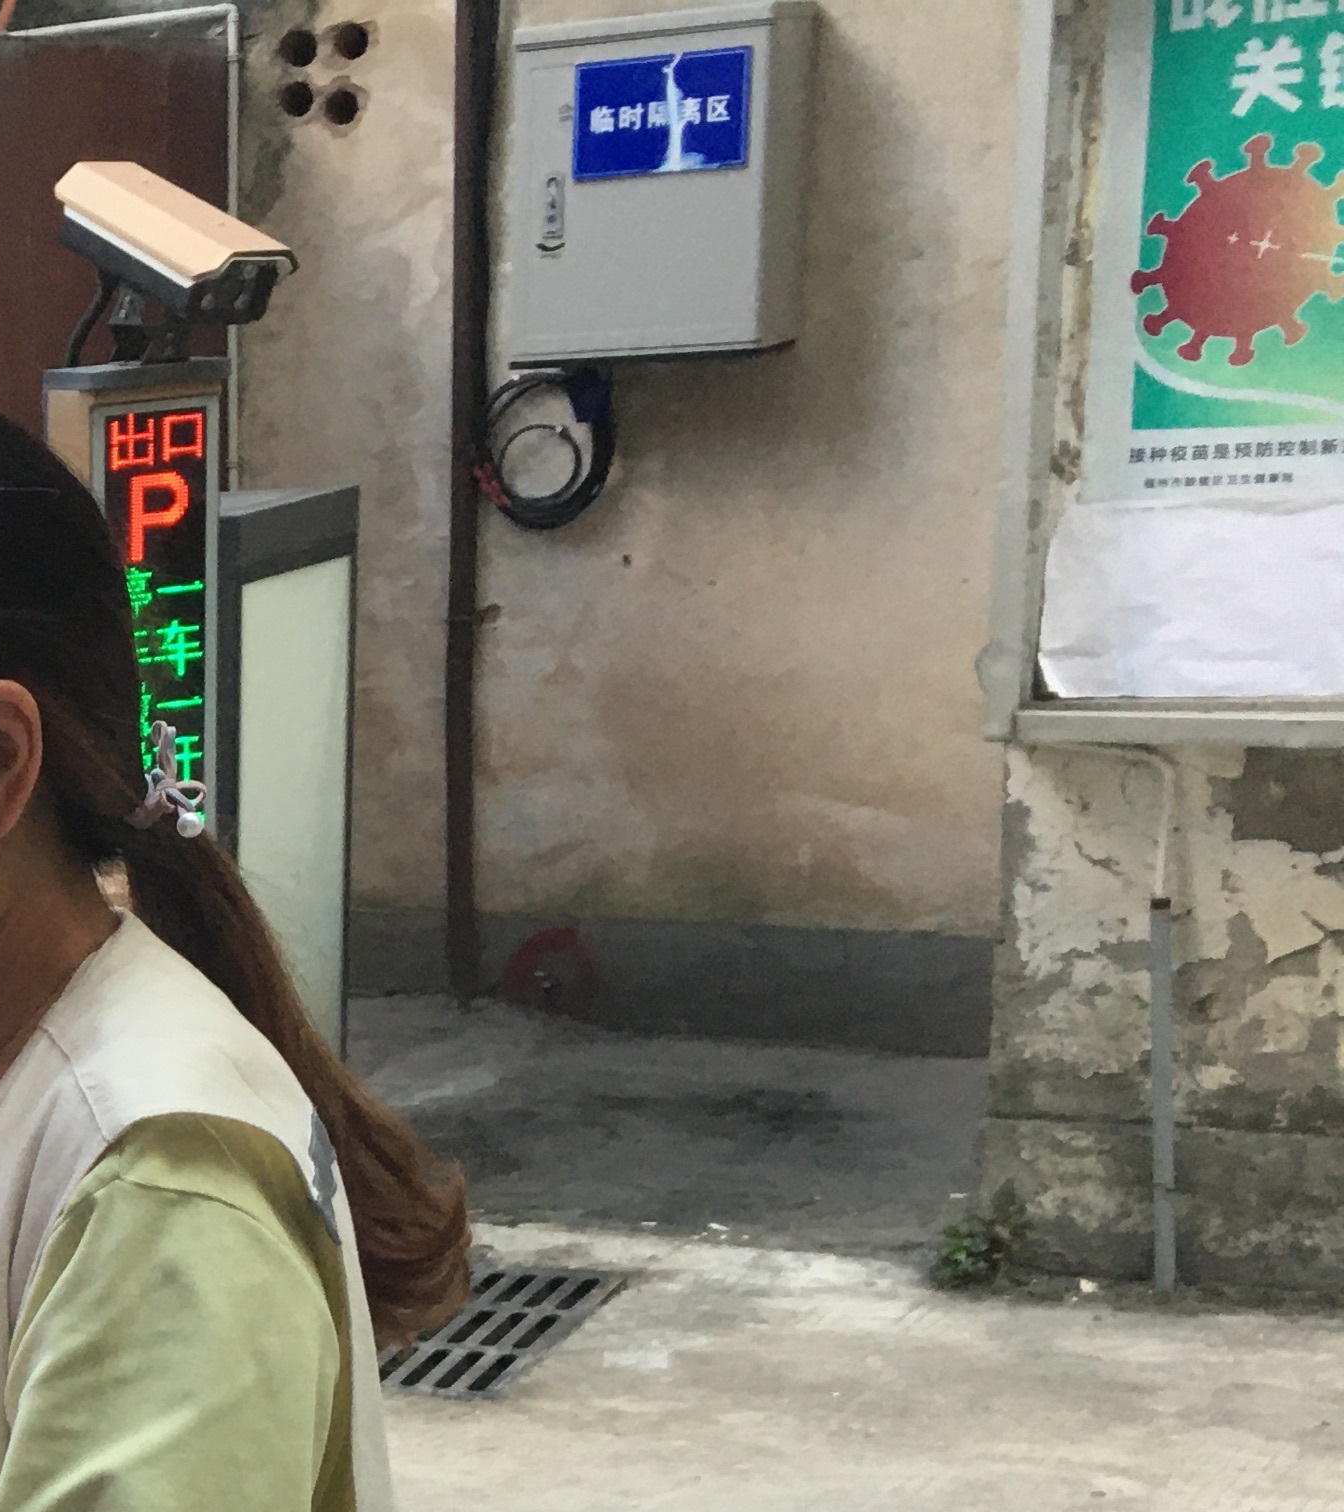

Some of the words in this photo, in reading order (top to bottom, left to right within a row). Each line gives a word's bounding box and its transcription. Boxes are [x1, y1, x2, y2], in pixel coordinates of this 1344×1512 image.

[110, 412, 203, 470] 出口
[1129, 438, 1344, 464] 接种疫苗是预防控制新
[129, 471, 189, 562] P
